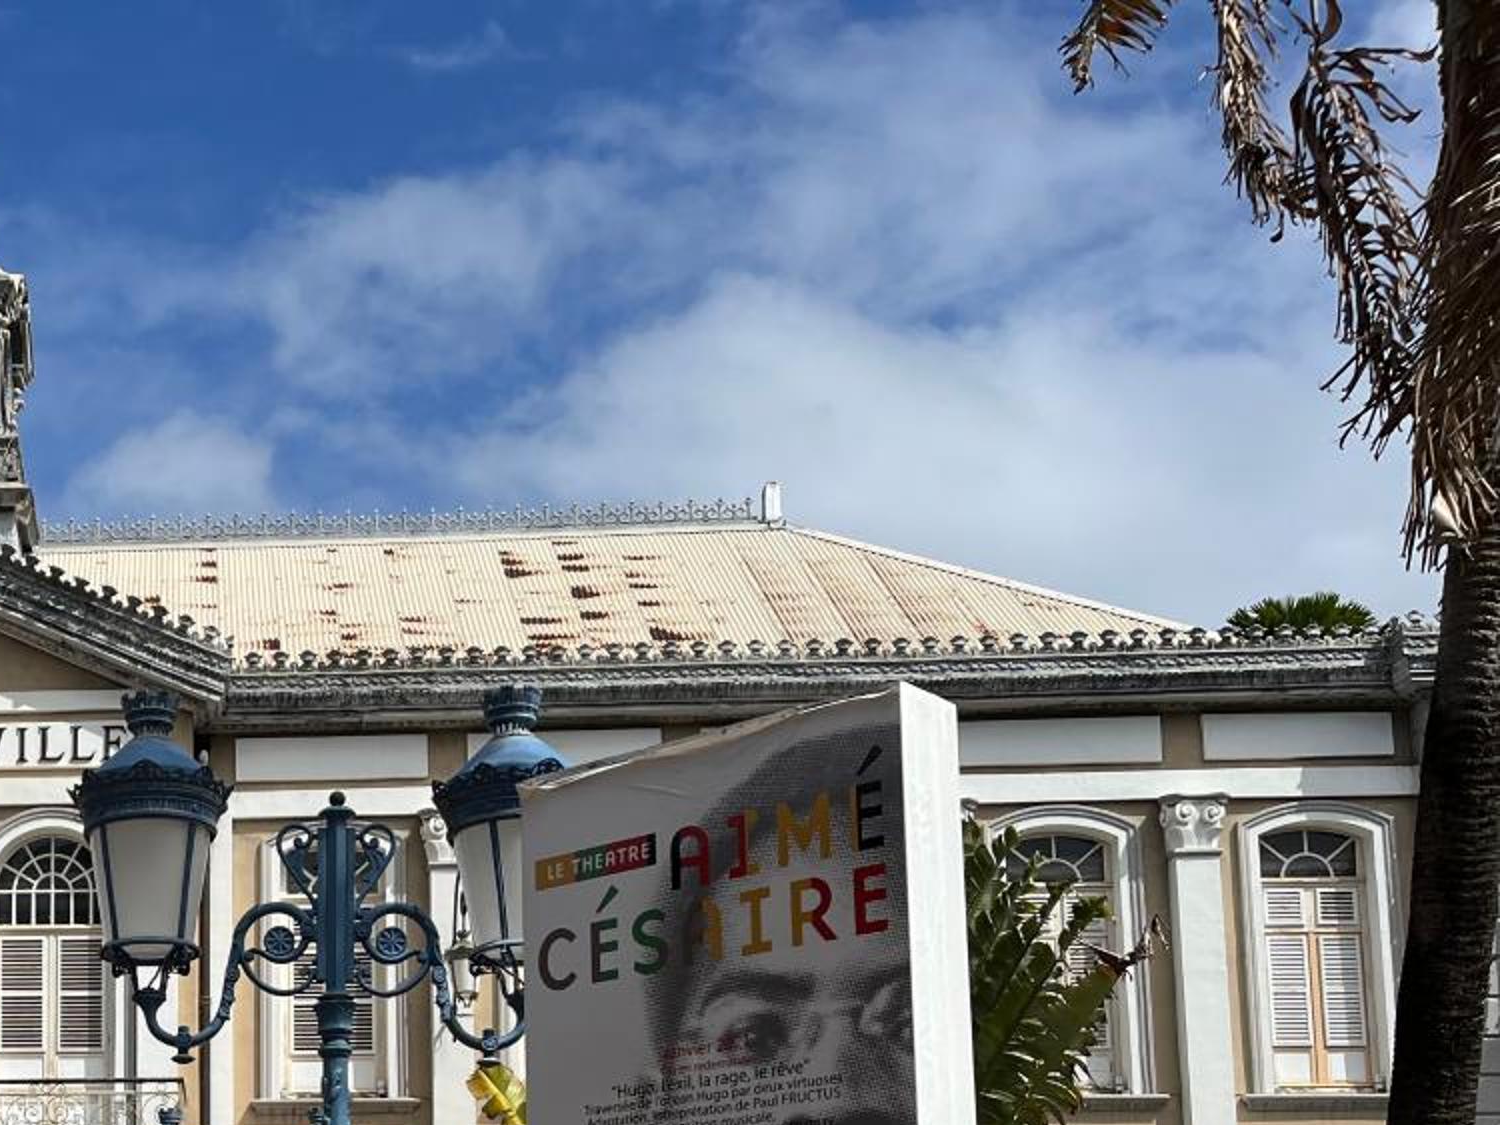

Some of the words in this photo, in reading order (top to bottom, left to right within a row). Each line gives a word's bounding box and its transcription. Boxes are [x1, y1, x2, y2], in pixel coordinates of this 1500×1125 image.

[670, 745, 886, 891] AIMÉ
[546, 864, 565, 882] LE
[537, 863, 891, 992] CÉSAIRE
[753, 1093, 779, 1109] Paul
